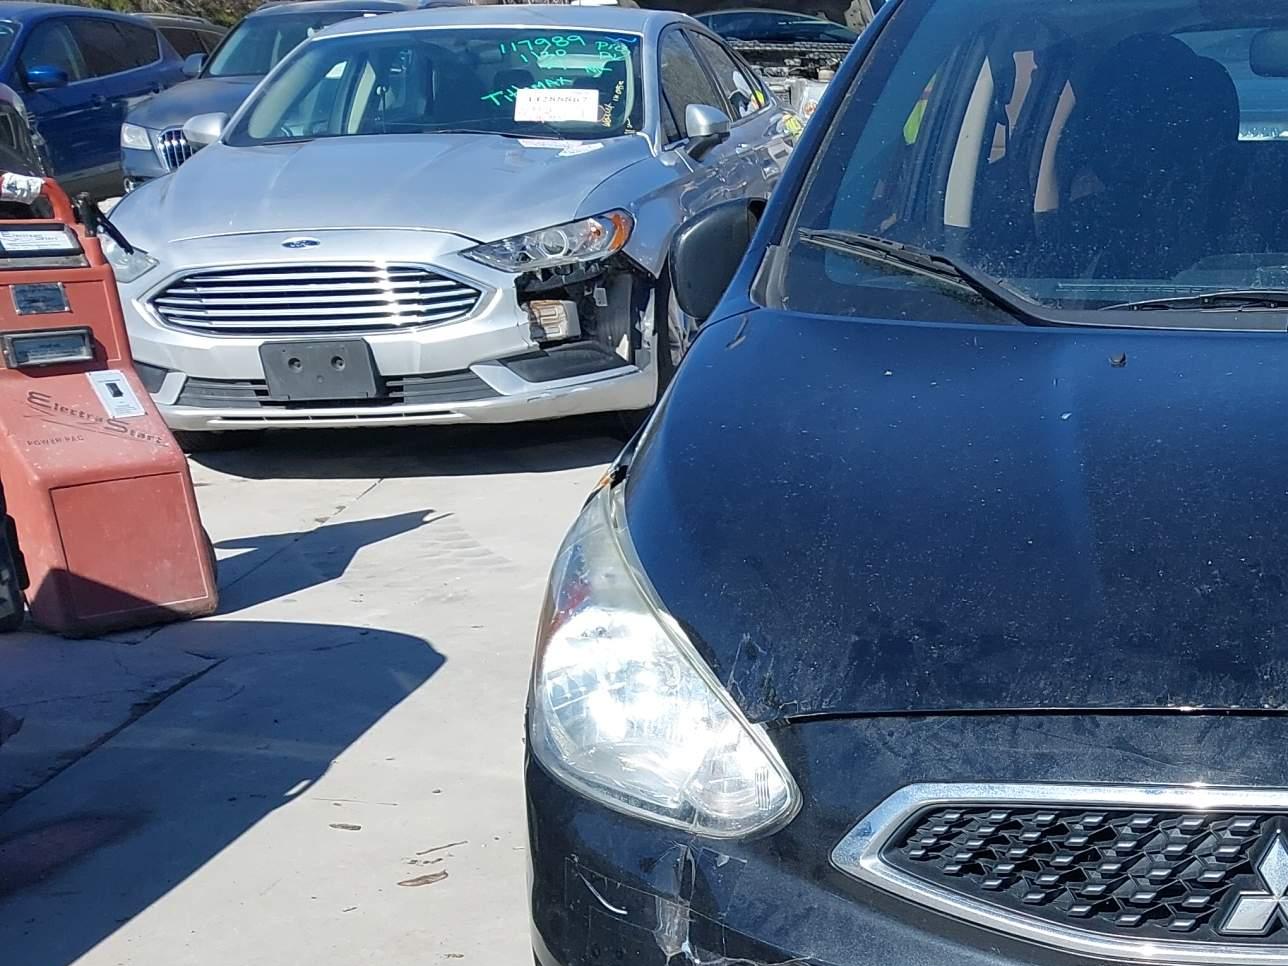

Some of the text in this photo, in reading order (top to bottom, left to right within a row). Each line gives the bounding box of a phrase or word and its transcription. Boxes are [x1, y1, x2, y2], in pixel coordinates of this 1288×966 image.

[500, 35, 586, 54] 117989
[27, 391, 103, 422] Electra
[104, 416, 163, 444] Start
